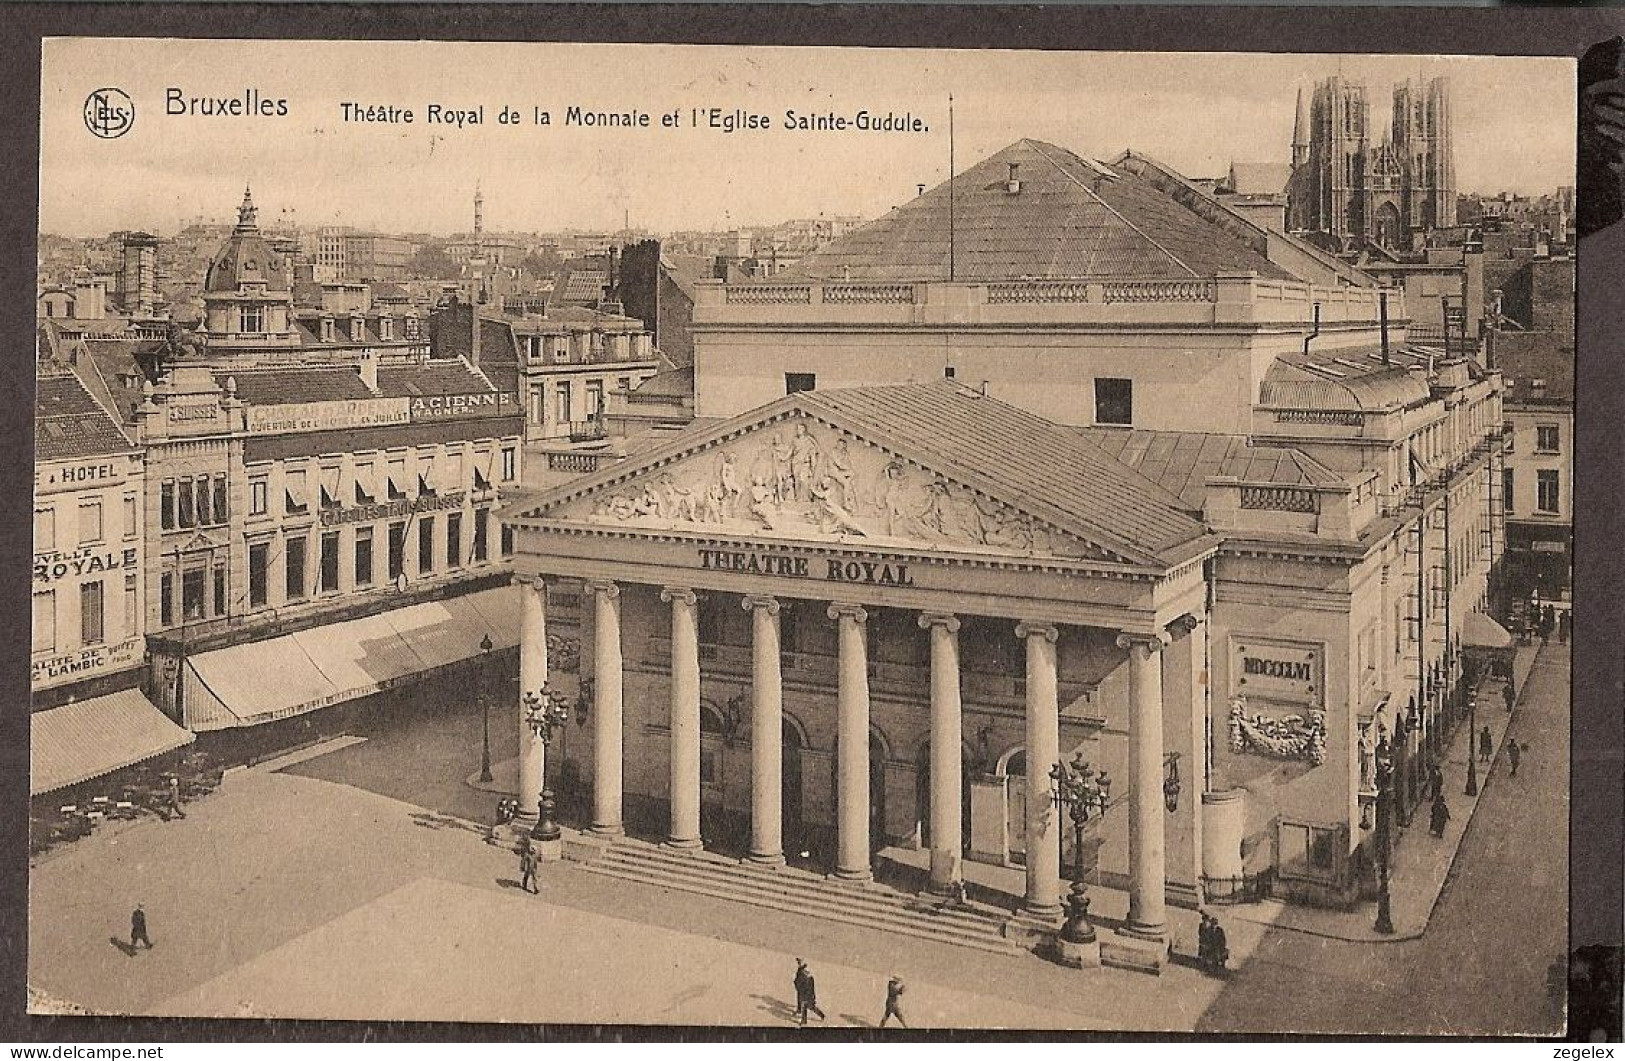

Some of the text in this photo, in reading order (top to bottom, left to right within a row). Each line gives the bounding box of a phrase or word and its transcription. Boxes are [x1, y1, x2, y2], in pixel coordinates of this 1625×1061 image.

[166, 88, 288, 116] Bruxelles
[341, 103, 930, 133] Théâtre Royal de la Monnaie et l'Eglise Sainte-Gudule.
[62, 464, 118, 483] HOTEL
[698, 549, 914, 586] THEATRE ROYAL
